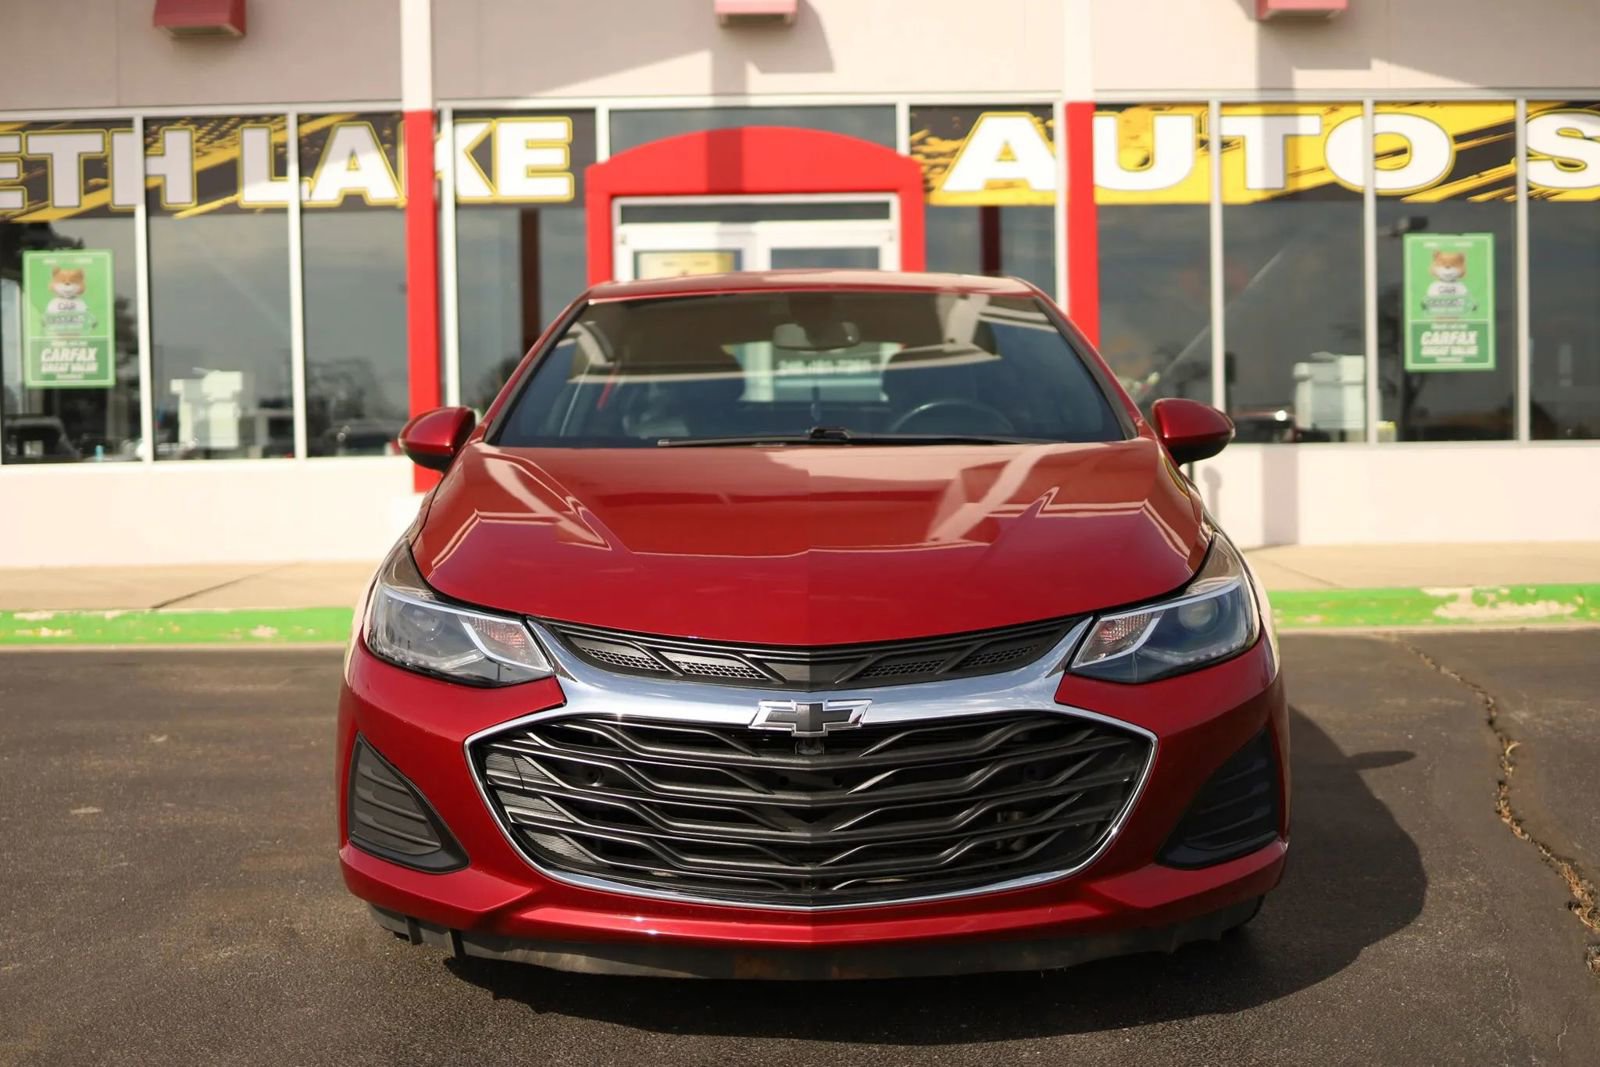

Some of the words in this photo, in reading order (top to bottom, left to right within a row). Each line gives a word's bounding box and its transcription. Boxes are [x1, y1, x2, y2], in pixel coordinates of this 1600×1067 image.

[238, 116, 574, 207] LAKE
[940, 112, 1454, 194] AUTO
[1421, 331, 1477, 345] CARFAX
[41, 347, 97, 362] CARFAX
